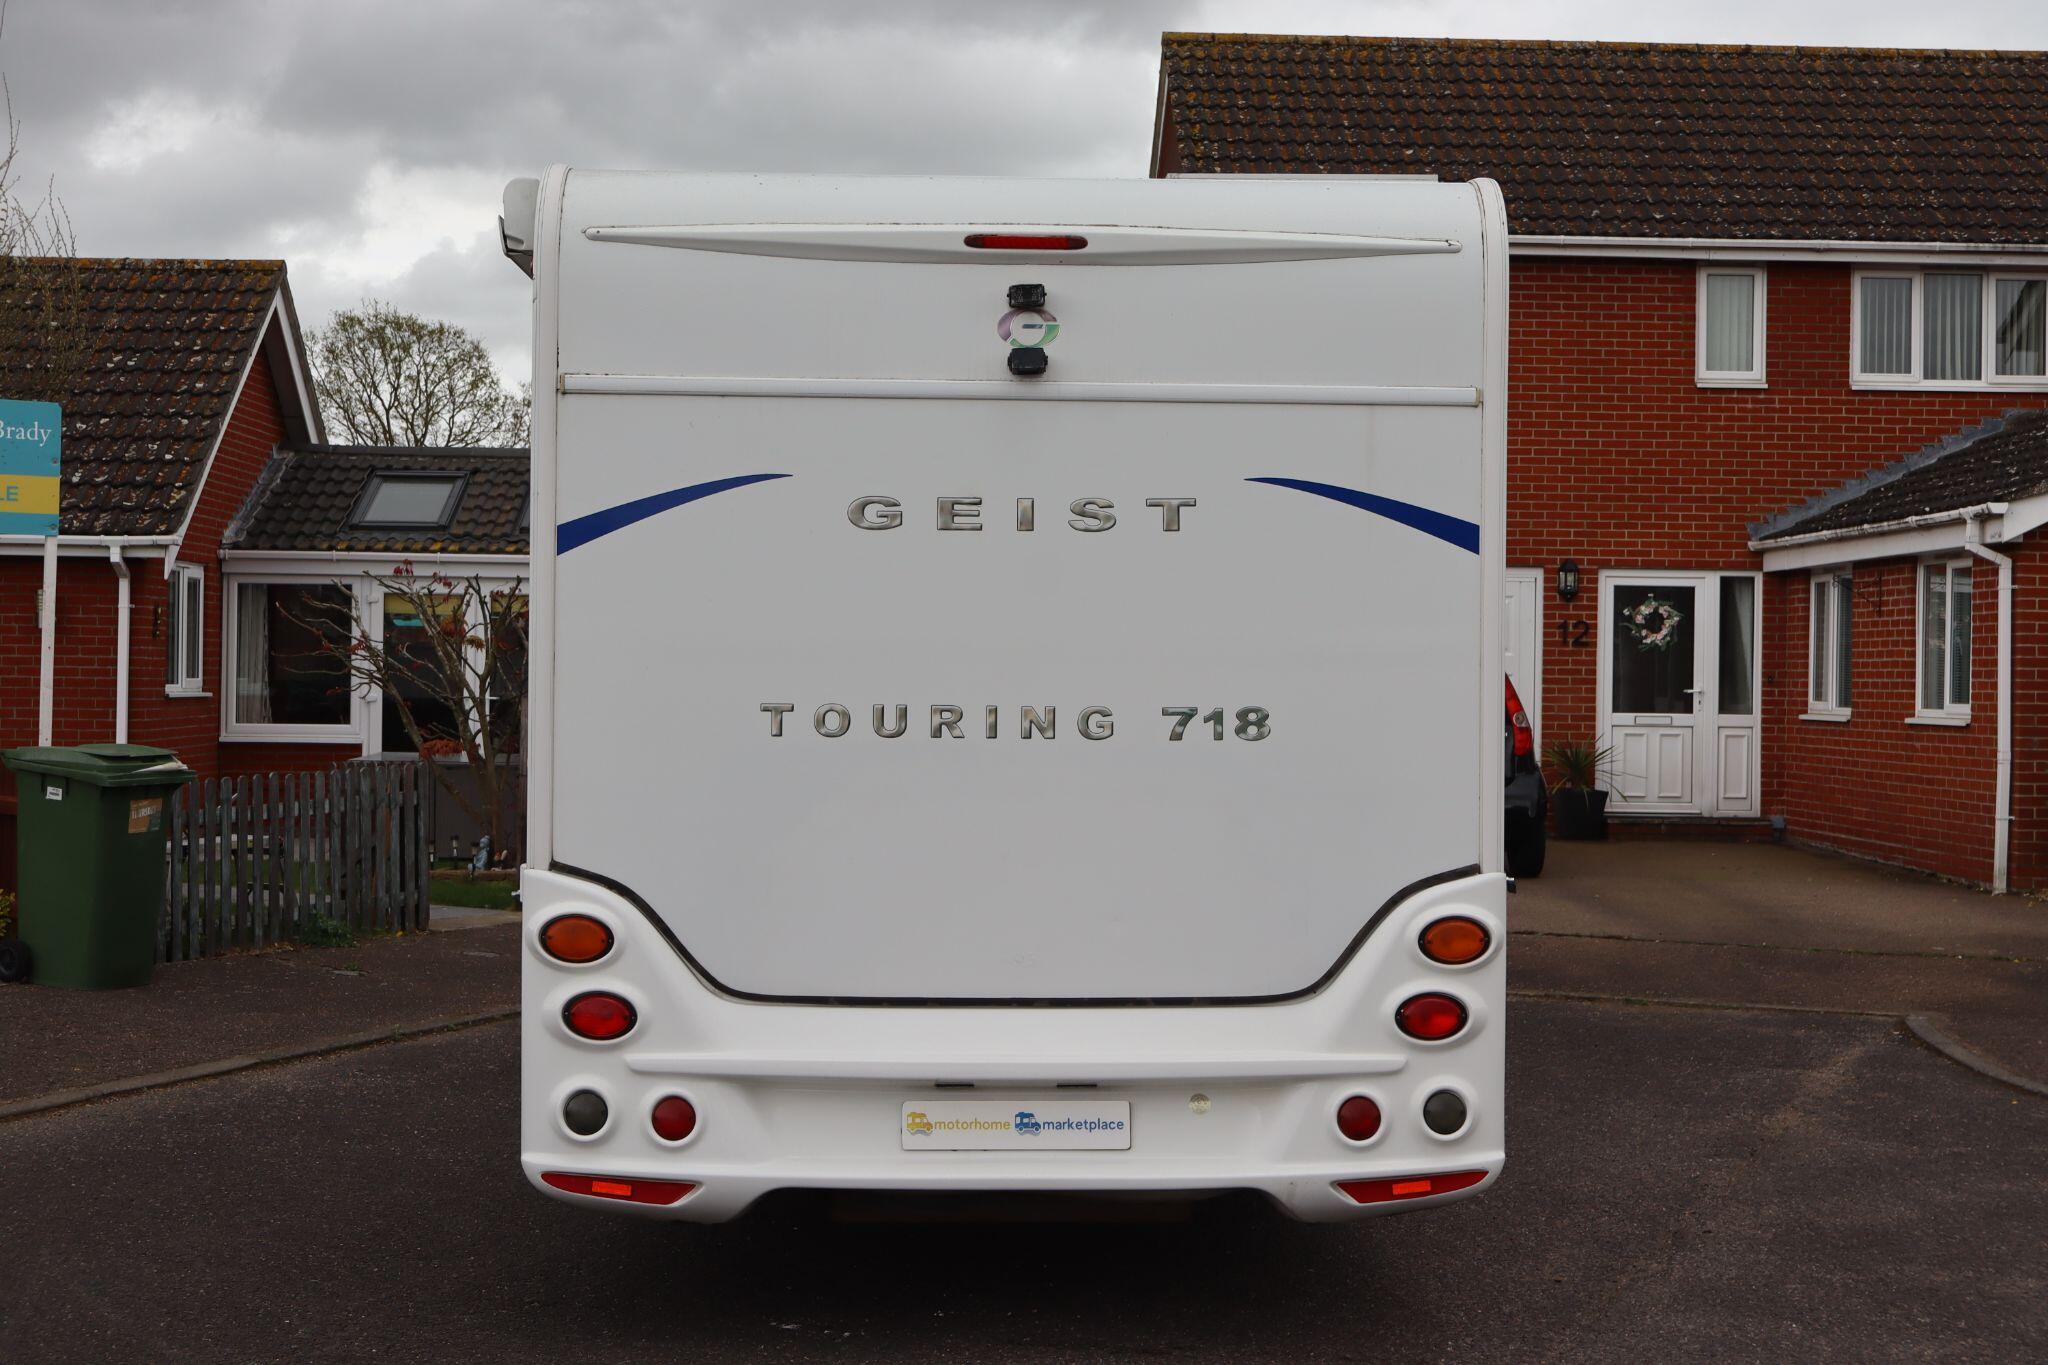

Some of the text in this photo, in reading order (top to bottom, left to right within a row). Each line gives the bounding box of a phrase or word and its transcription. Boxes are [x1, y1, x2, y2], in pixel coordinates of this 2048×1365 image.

[847, 495, 1197, 532] GEIST
[1557, 619, 1591, 647] 12
[760, 702, 1272, 742] TOURING 718
[934, 1117, 1124, 1133] motorhome marketplace
